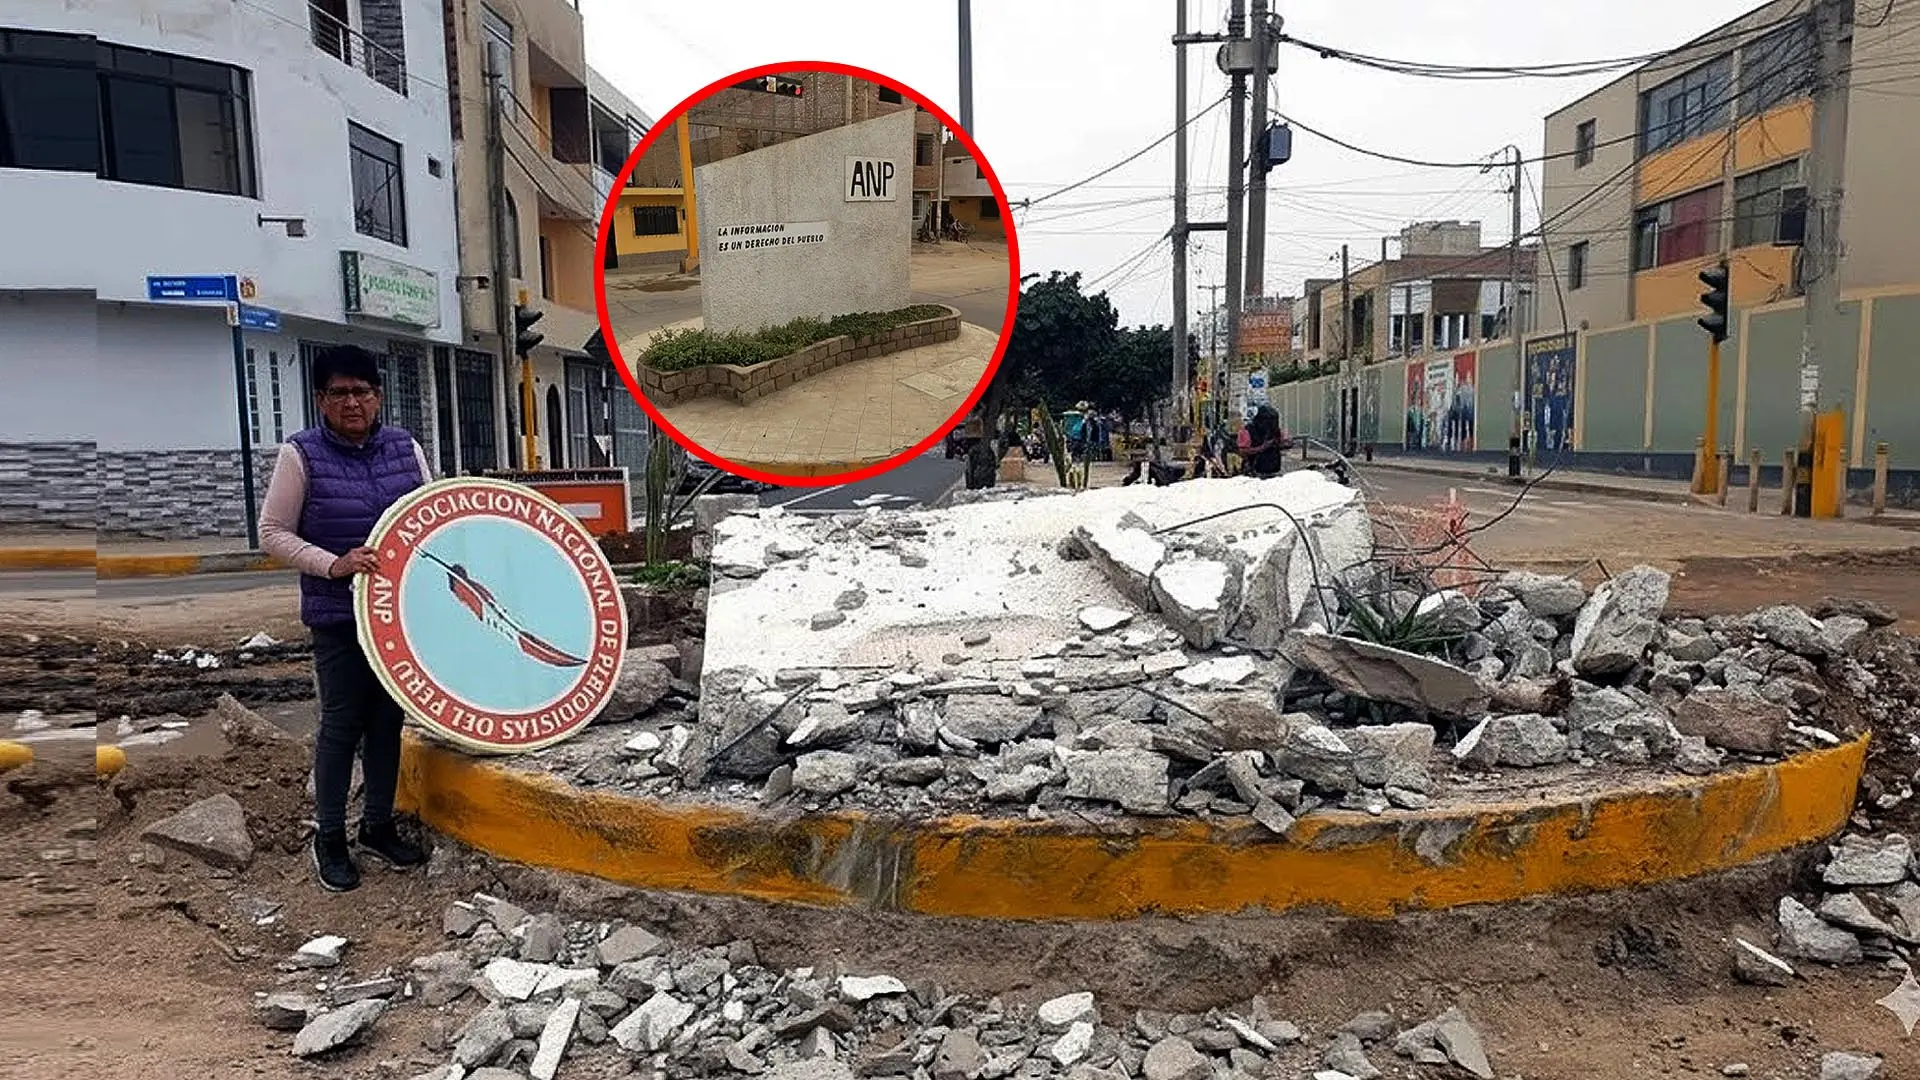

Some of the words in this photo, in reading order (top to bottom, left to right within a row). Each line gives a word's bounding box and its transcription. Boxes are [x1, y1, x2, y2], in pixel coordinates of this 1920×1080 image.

[851, 161, 895, 197] ANP
[718, 227, 728, 236] LA
[731, 224, 785, 236] INFORMACION
[719, 242, 729, 252] ES
[731, 241, 742, 251] UN
[745, 238, 780, 249] DERECHO
[782, 236, 795, 245] DEL
[797, 234, 824, 244] PUEBLO
[397, 491, 530, 546] ASOCIACION
[535, 507, 614, 611] NACIONAL
[373, 575, 393, 624] ANP
[600, 619, 618, 649] DE
[392, 660, 450, 718] PERU
